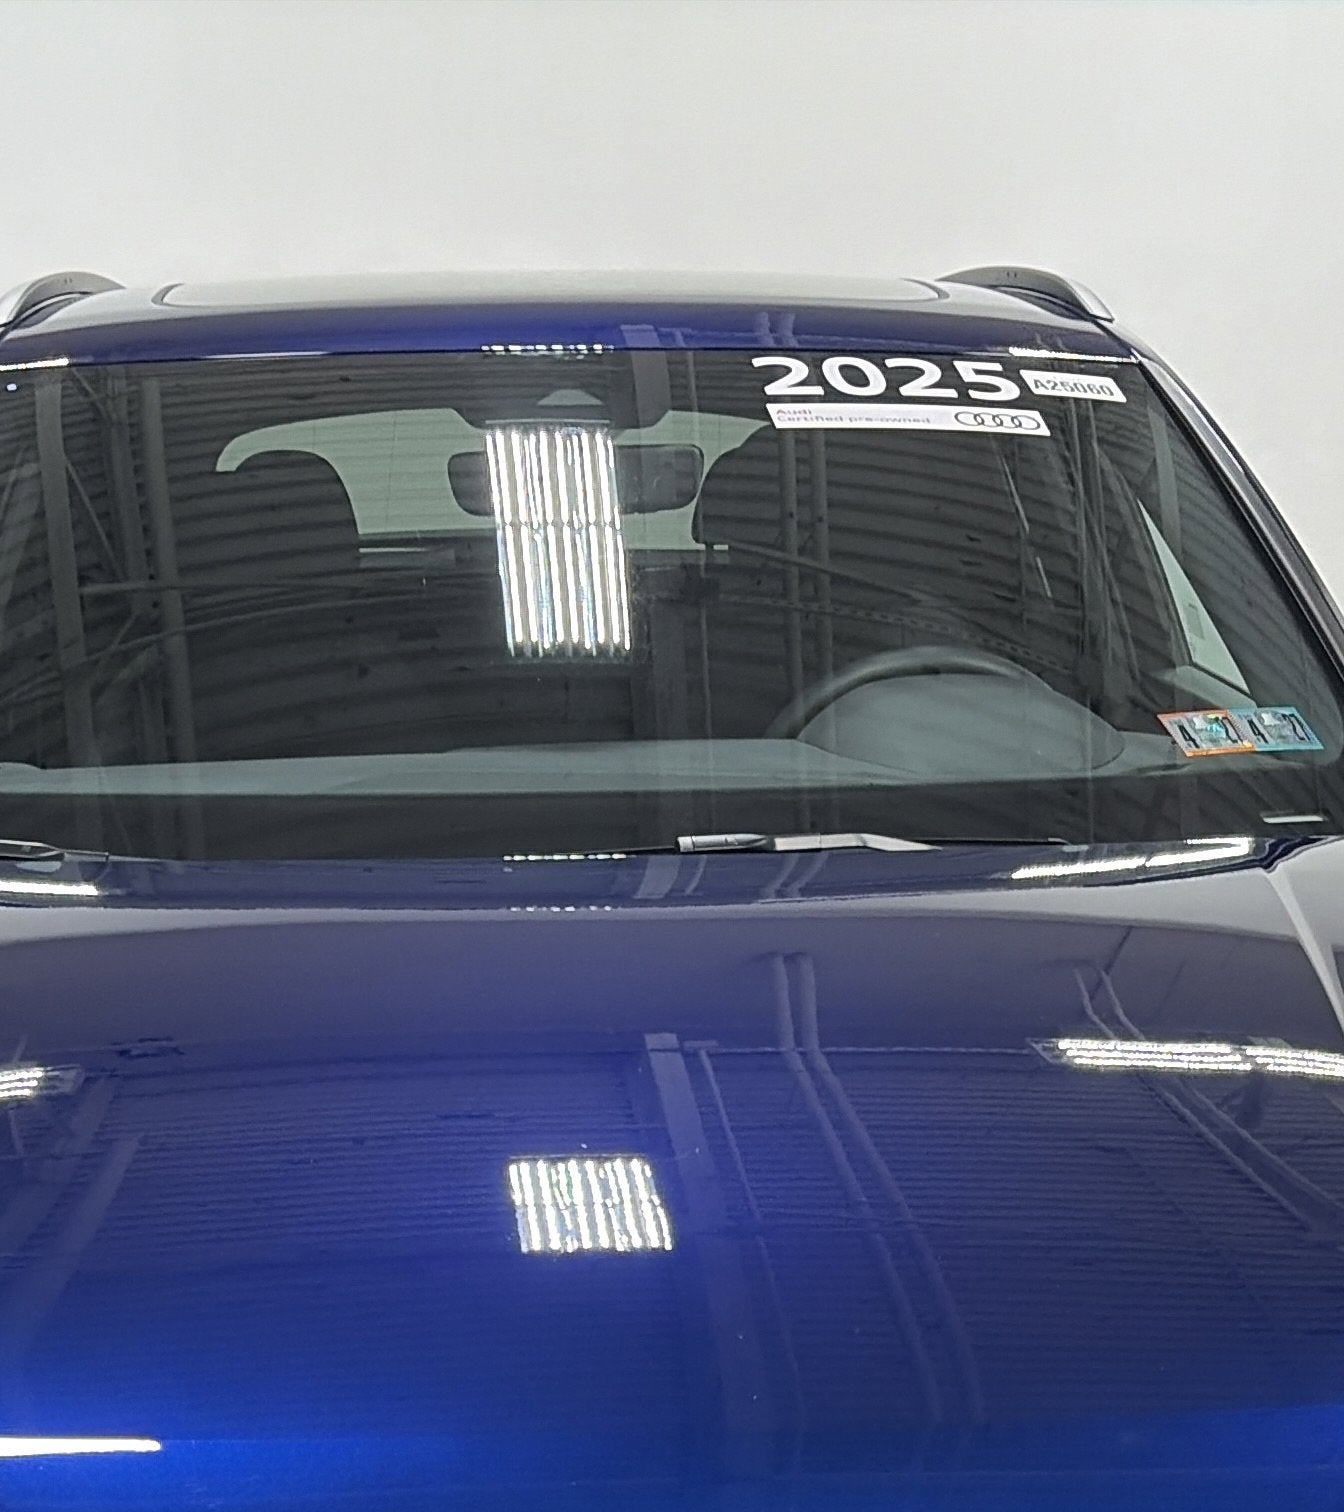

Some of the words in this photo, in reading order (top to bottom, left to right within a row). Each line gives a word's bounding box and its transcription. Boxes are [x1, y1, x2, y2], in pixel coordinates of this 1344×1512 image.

[751, 356, 1021, 401] 2025
[1033, 378, 1115, 397] A25060
[776, 408, 813, 416] Audi
[777, 414, 843, 423] Certified
